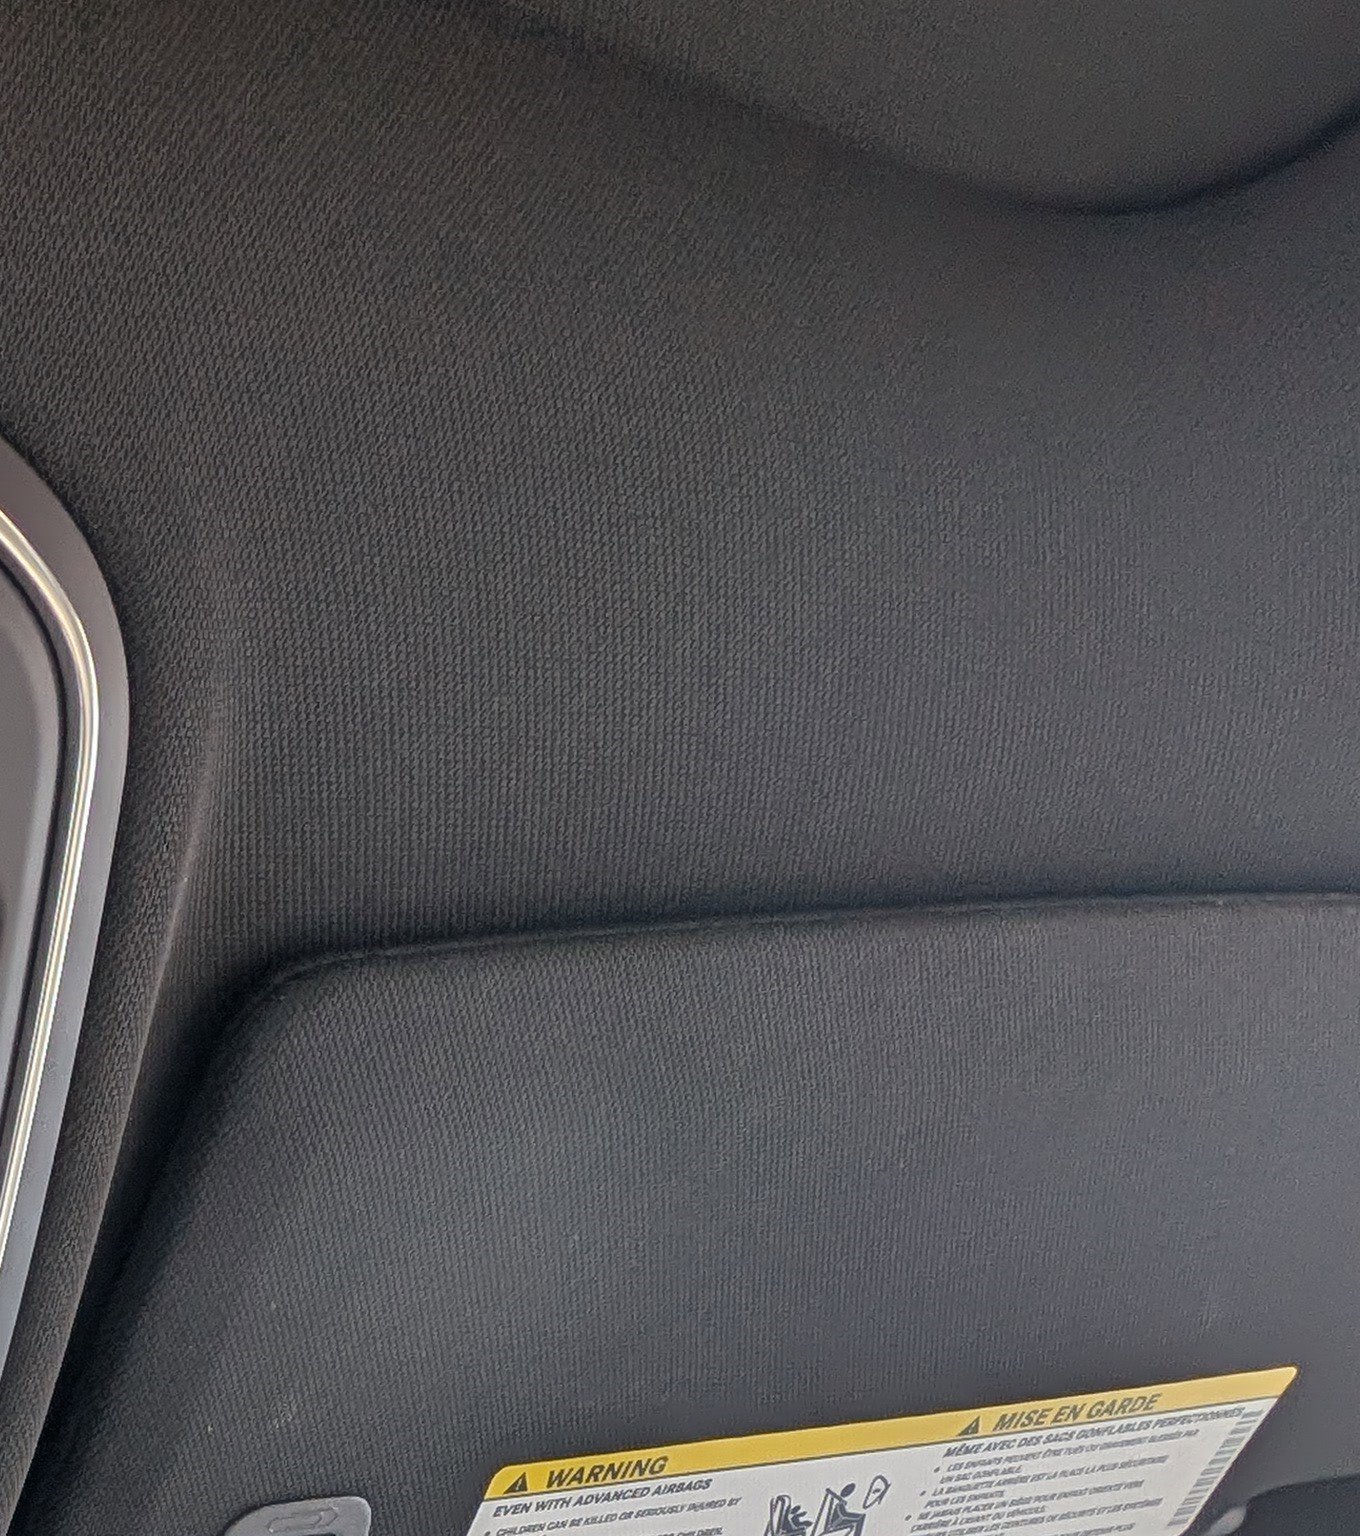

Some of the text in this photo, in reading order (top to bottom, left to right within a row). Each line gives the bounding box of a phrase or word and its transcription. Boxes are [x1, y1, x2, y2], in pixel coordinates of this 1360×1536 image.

[992, 1393, 1163, 1431] MISE EN GARDE
[546, 1456, 668, 1489] WARNING
[493, 1479, 713, 1517] EVEN WITH ADVANCED AIRBAGS
[496, 1522, 546, 1536] CHILDREN
